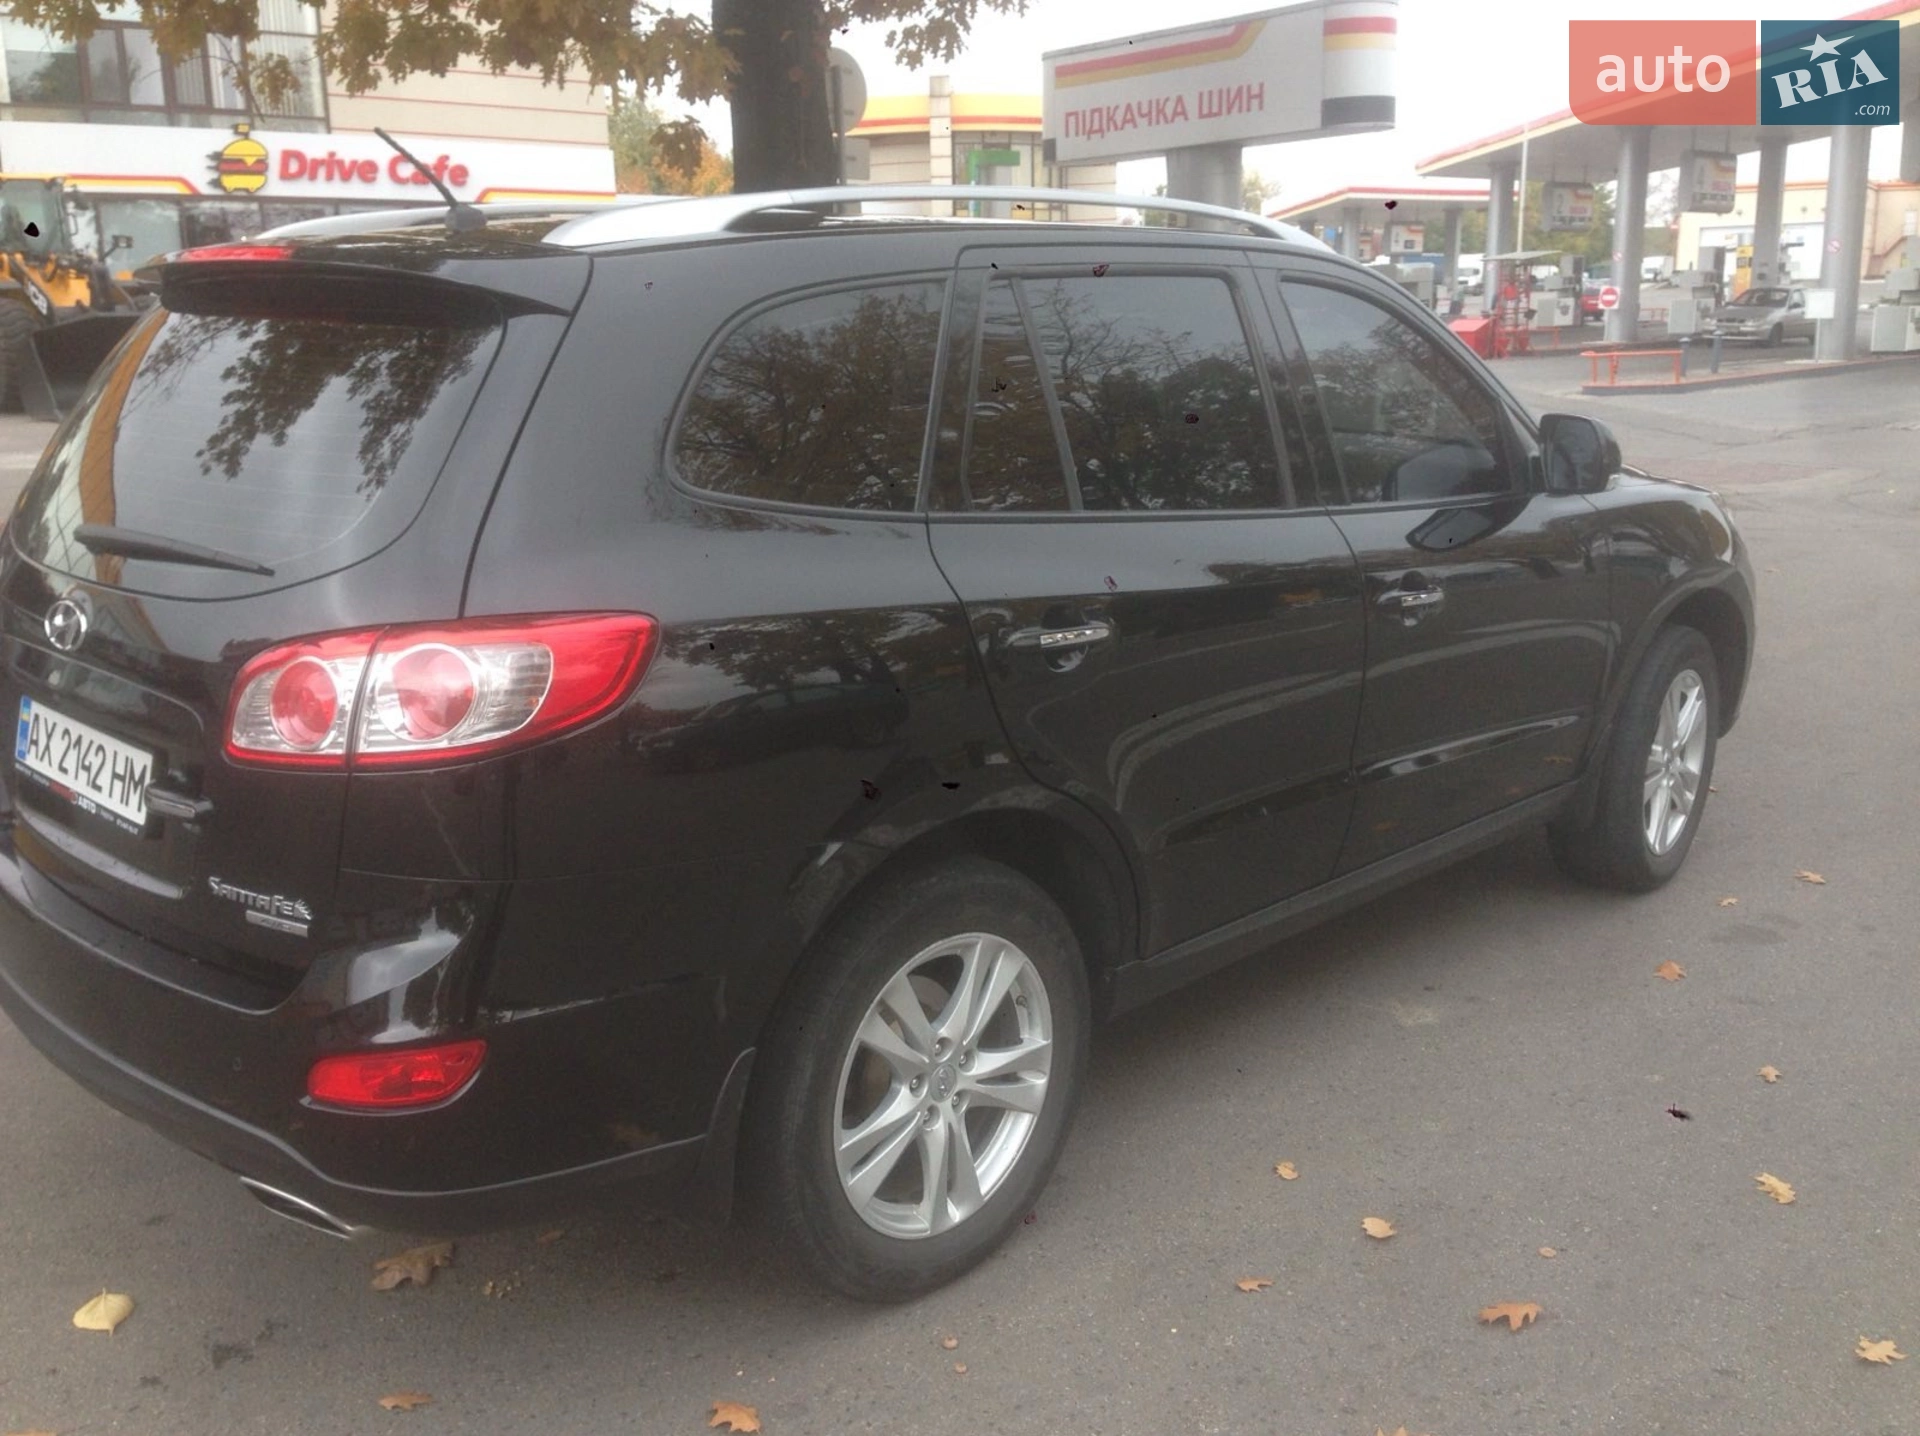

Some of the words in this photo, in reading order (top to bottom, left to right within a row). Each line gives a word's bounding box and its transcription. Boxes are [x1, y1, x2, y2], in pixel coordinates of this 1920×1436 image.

[1064, 94, 1190, 141] ПІДКАЧКА
[1197, 81, 1265, 119] ШИН
[279, 149, 378, 183] Drive
[388, 154, 470, 188] Cafe
[27, 712, 57, 768] AX
[58, 727, 106, 794] 2142
[109, 750, 147, 813] HM
